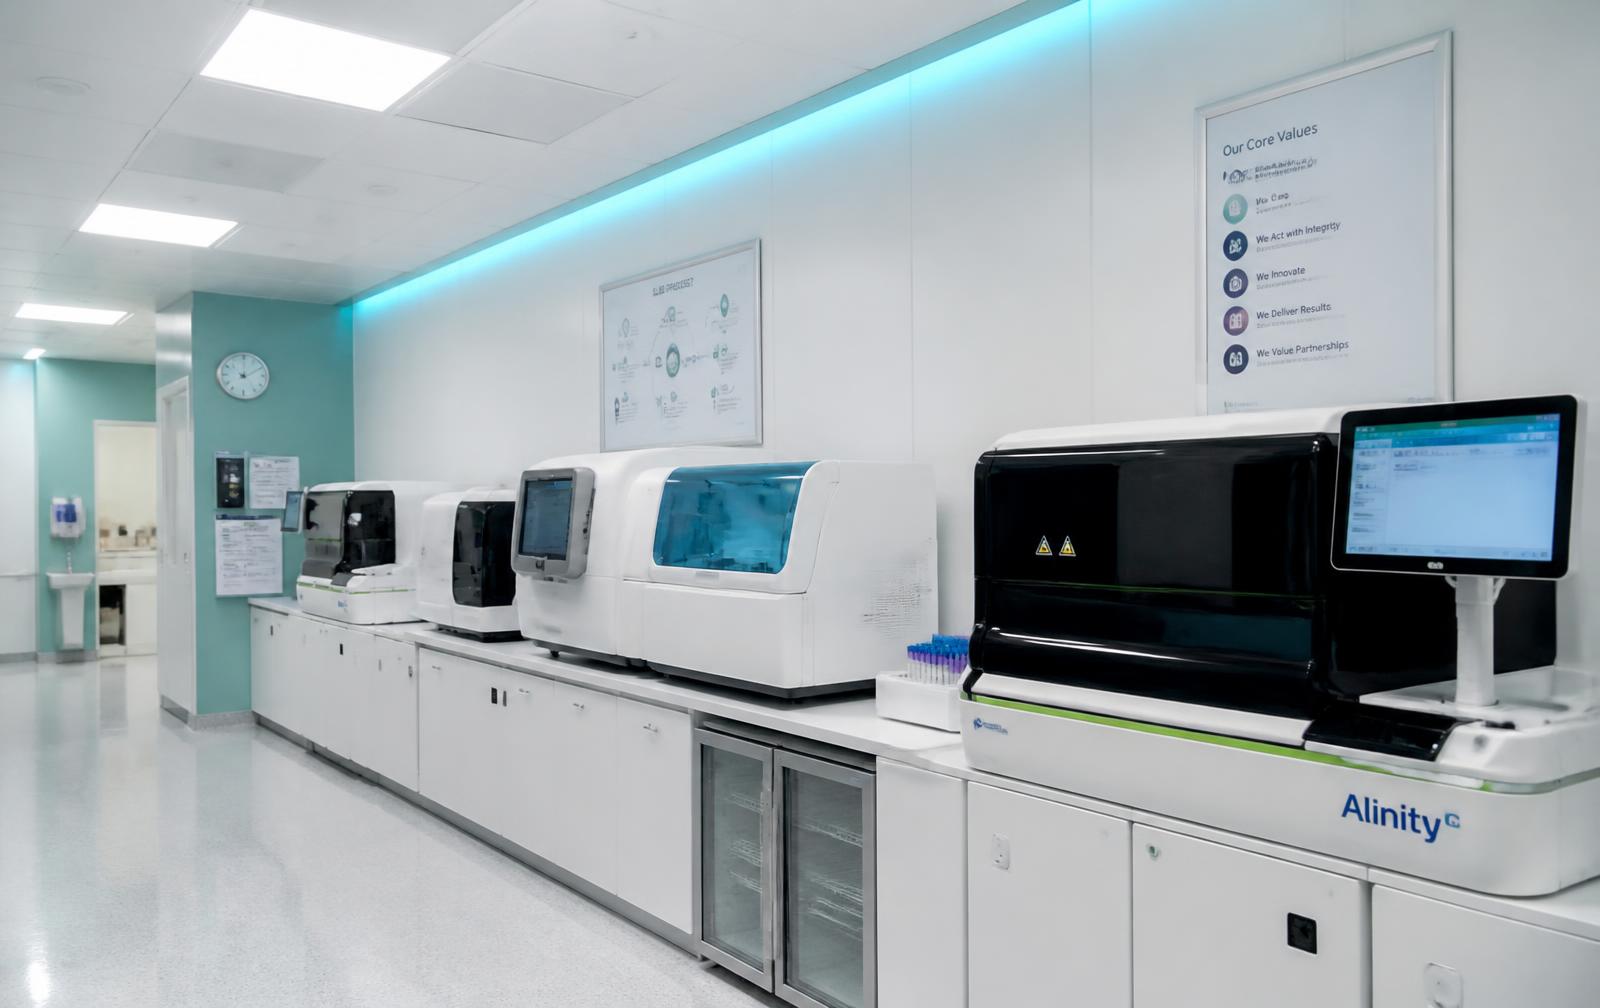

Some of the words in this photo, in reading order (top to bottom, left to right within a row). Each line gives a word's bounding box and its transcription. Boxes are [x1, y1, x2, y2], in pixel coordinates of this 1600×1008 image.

[1223, 144, 1244, 157] Our
[1246, 136, 1275, 151] Core
[1277, 124, 1318, 142] Values
[1256, 233, 1269, 244] We
[1271, 231, 1284, 240] Act
[1286, 227, 1304, 237] with
[1256, 272, 1269, 281] We
[1271, 266, 1306, 278] Innovate
[1256, 311, 1269, 320] We
[1271, 307, 1299, 318] Deliver
[1300, 304, 1332, 314] Results
[1256, 349, 1270, 358] We
[1296, 341, 1350, 355] Partnerships
[1341, 793, 1441, 843] Alinity
